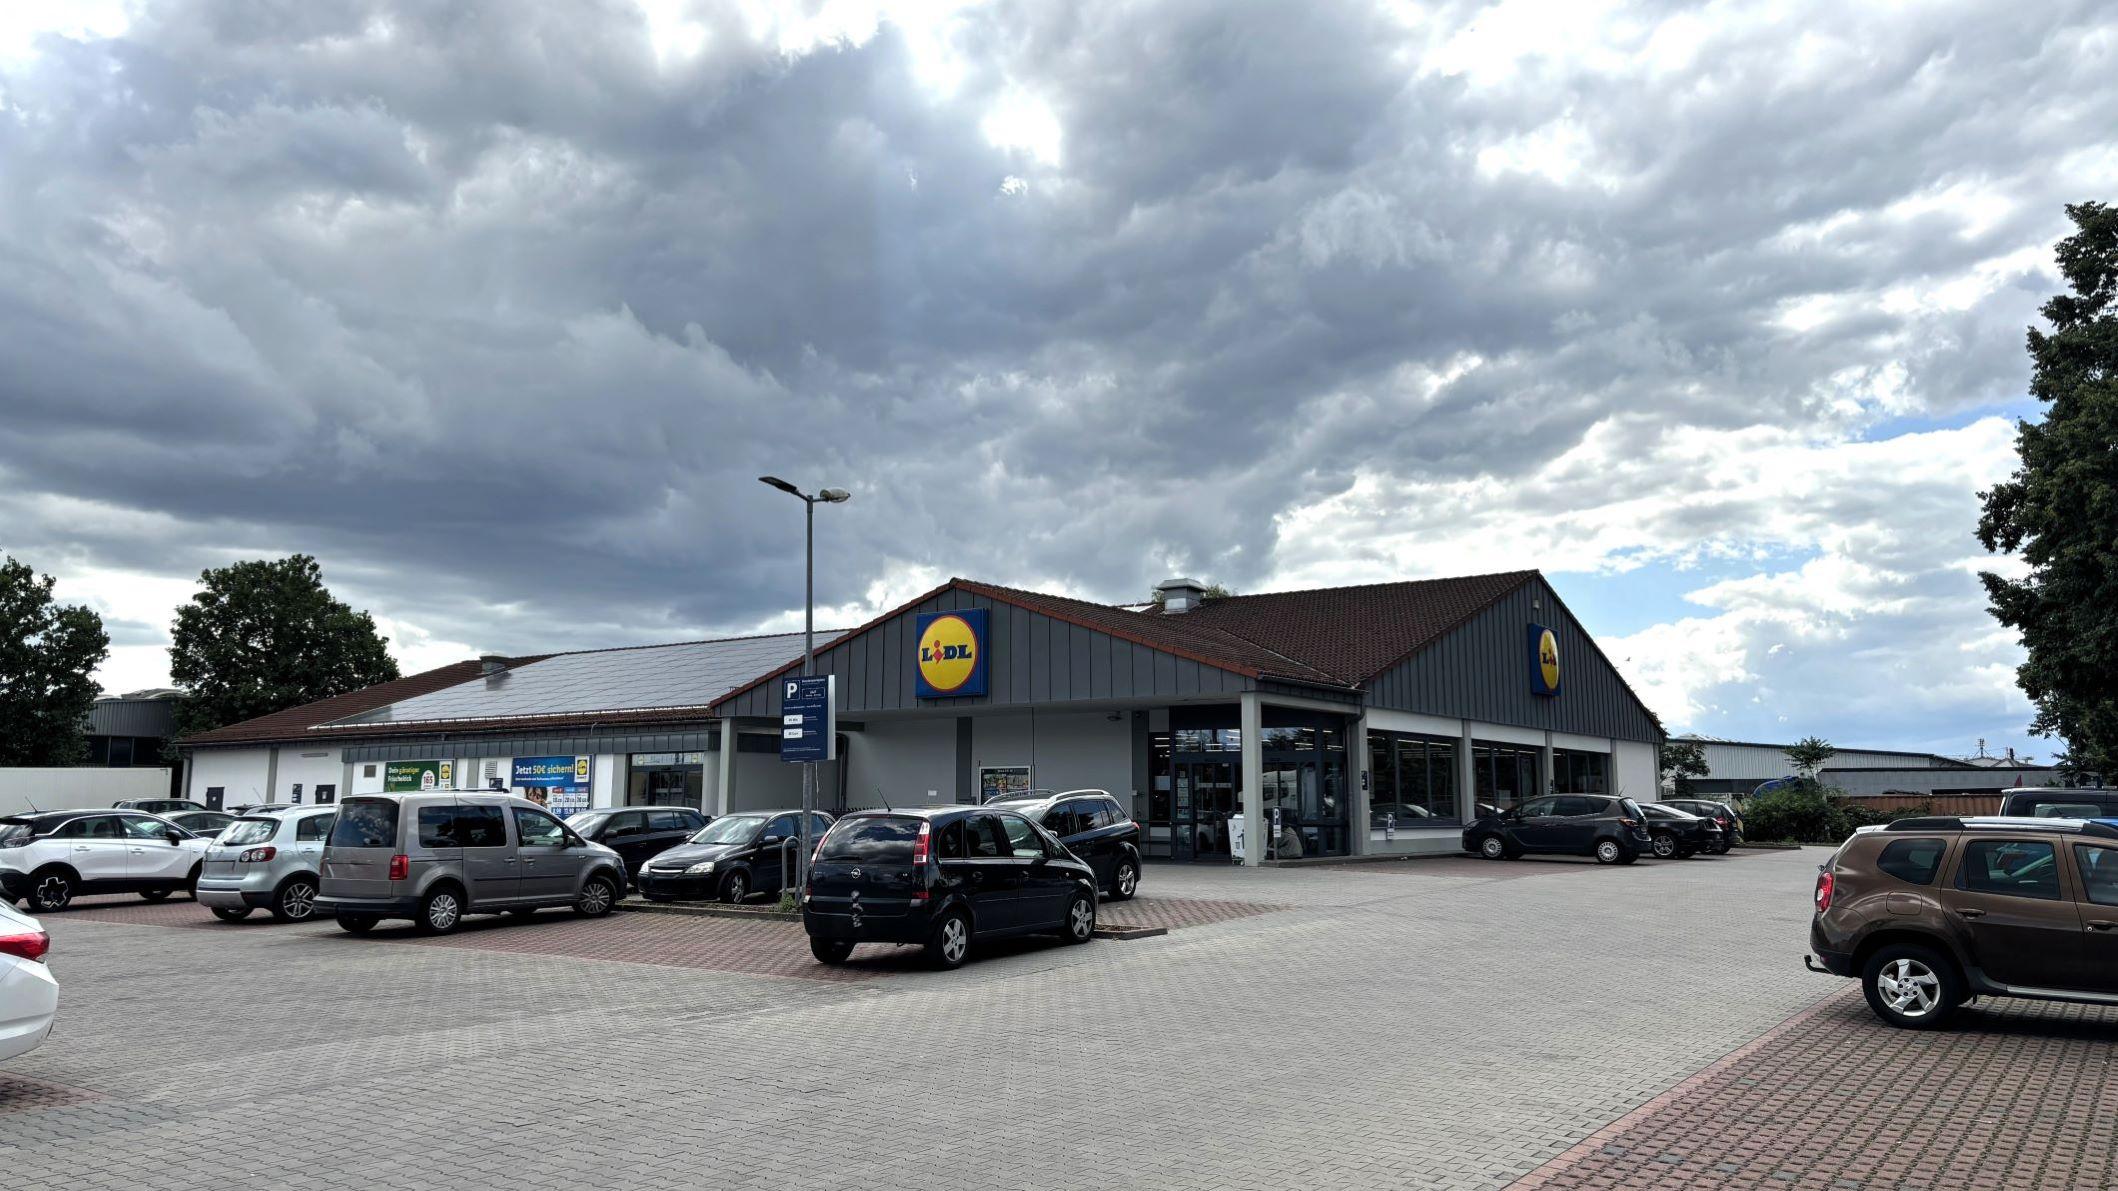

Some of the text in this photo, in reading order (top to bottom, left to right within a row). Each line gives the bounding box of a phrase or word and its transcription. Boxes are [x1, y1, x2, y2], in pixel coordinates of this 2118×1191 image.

[921, 640, 973, 665] LIDL
[787, 682, 798, 699] P
[516, 766, 532, 774] Jetzt
[532, 765, 546, 774] 50€
[548, 764, 574, 774] sichern!
